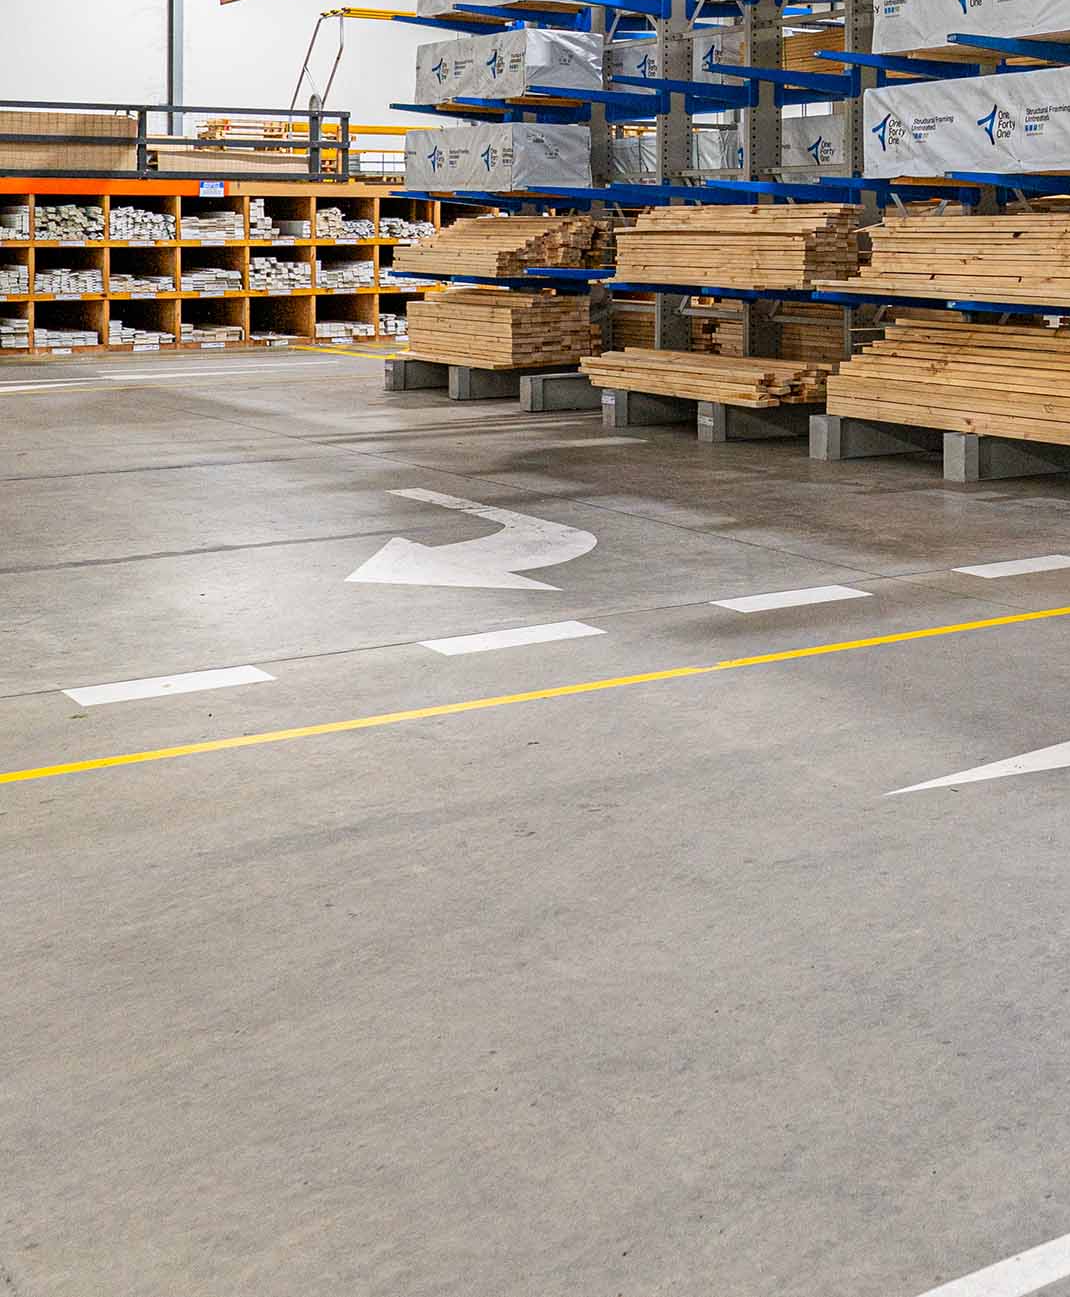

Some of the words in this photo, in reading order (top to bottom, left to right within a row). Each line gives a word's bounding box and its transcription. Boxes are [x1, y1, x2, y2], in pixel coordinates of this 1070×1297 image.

[998, 110, 1011, 120] One
[1026, 107, 1048, 116] Structural
[1048, 105, 1070, 114] Framing
[1025, 114, 1049, 123] Untreated
[888, 119, 901, 128] One
[998, 119, 1016, 131] Forty
[888, 128, 906, 138] Forty
[996, 129, 1011, 138] One
[888, 136, 900, 145] One
[820, 147, 834, 155] Forty
[820, 154, 831, 162] One
